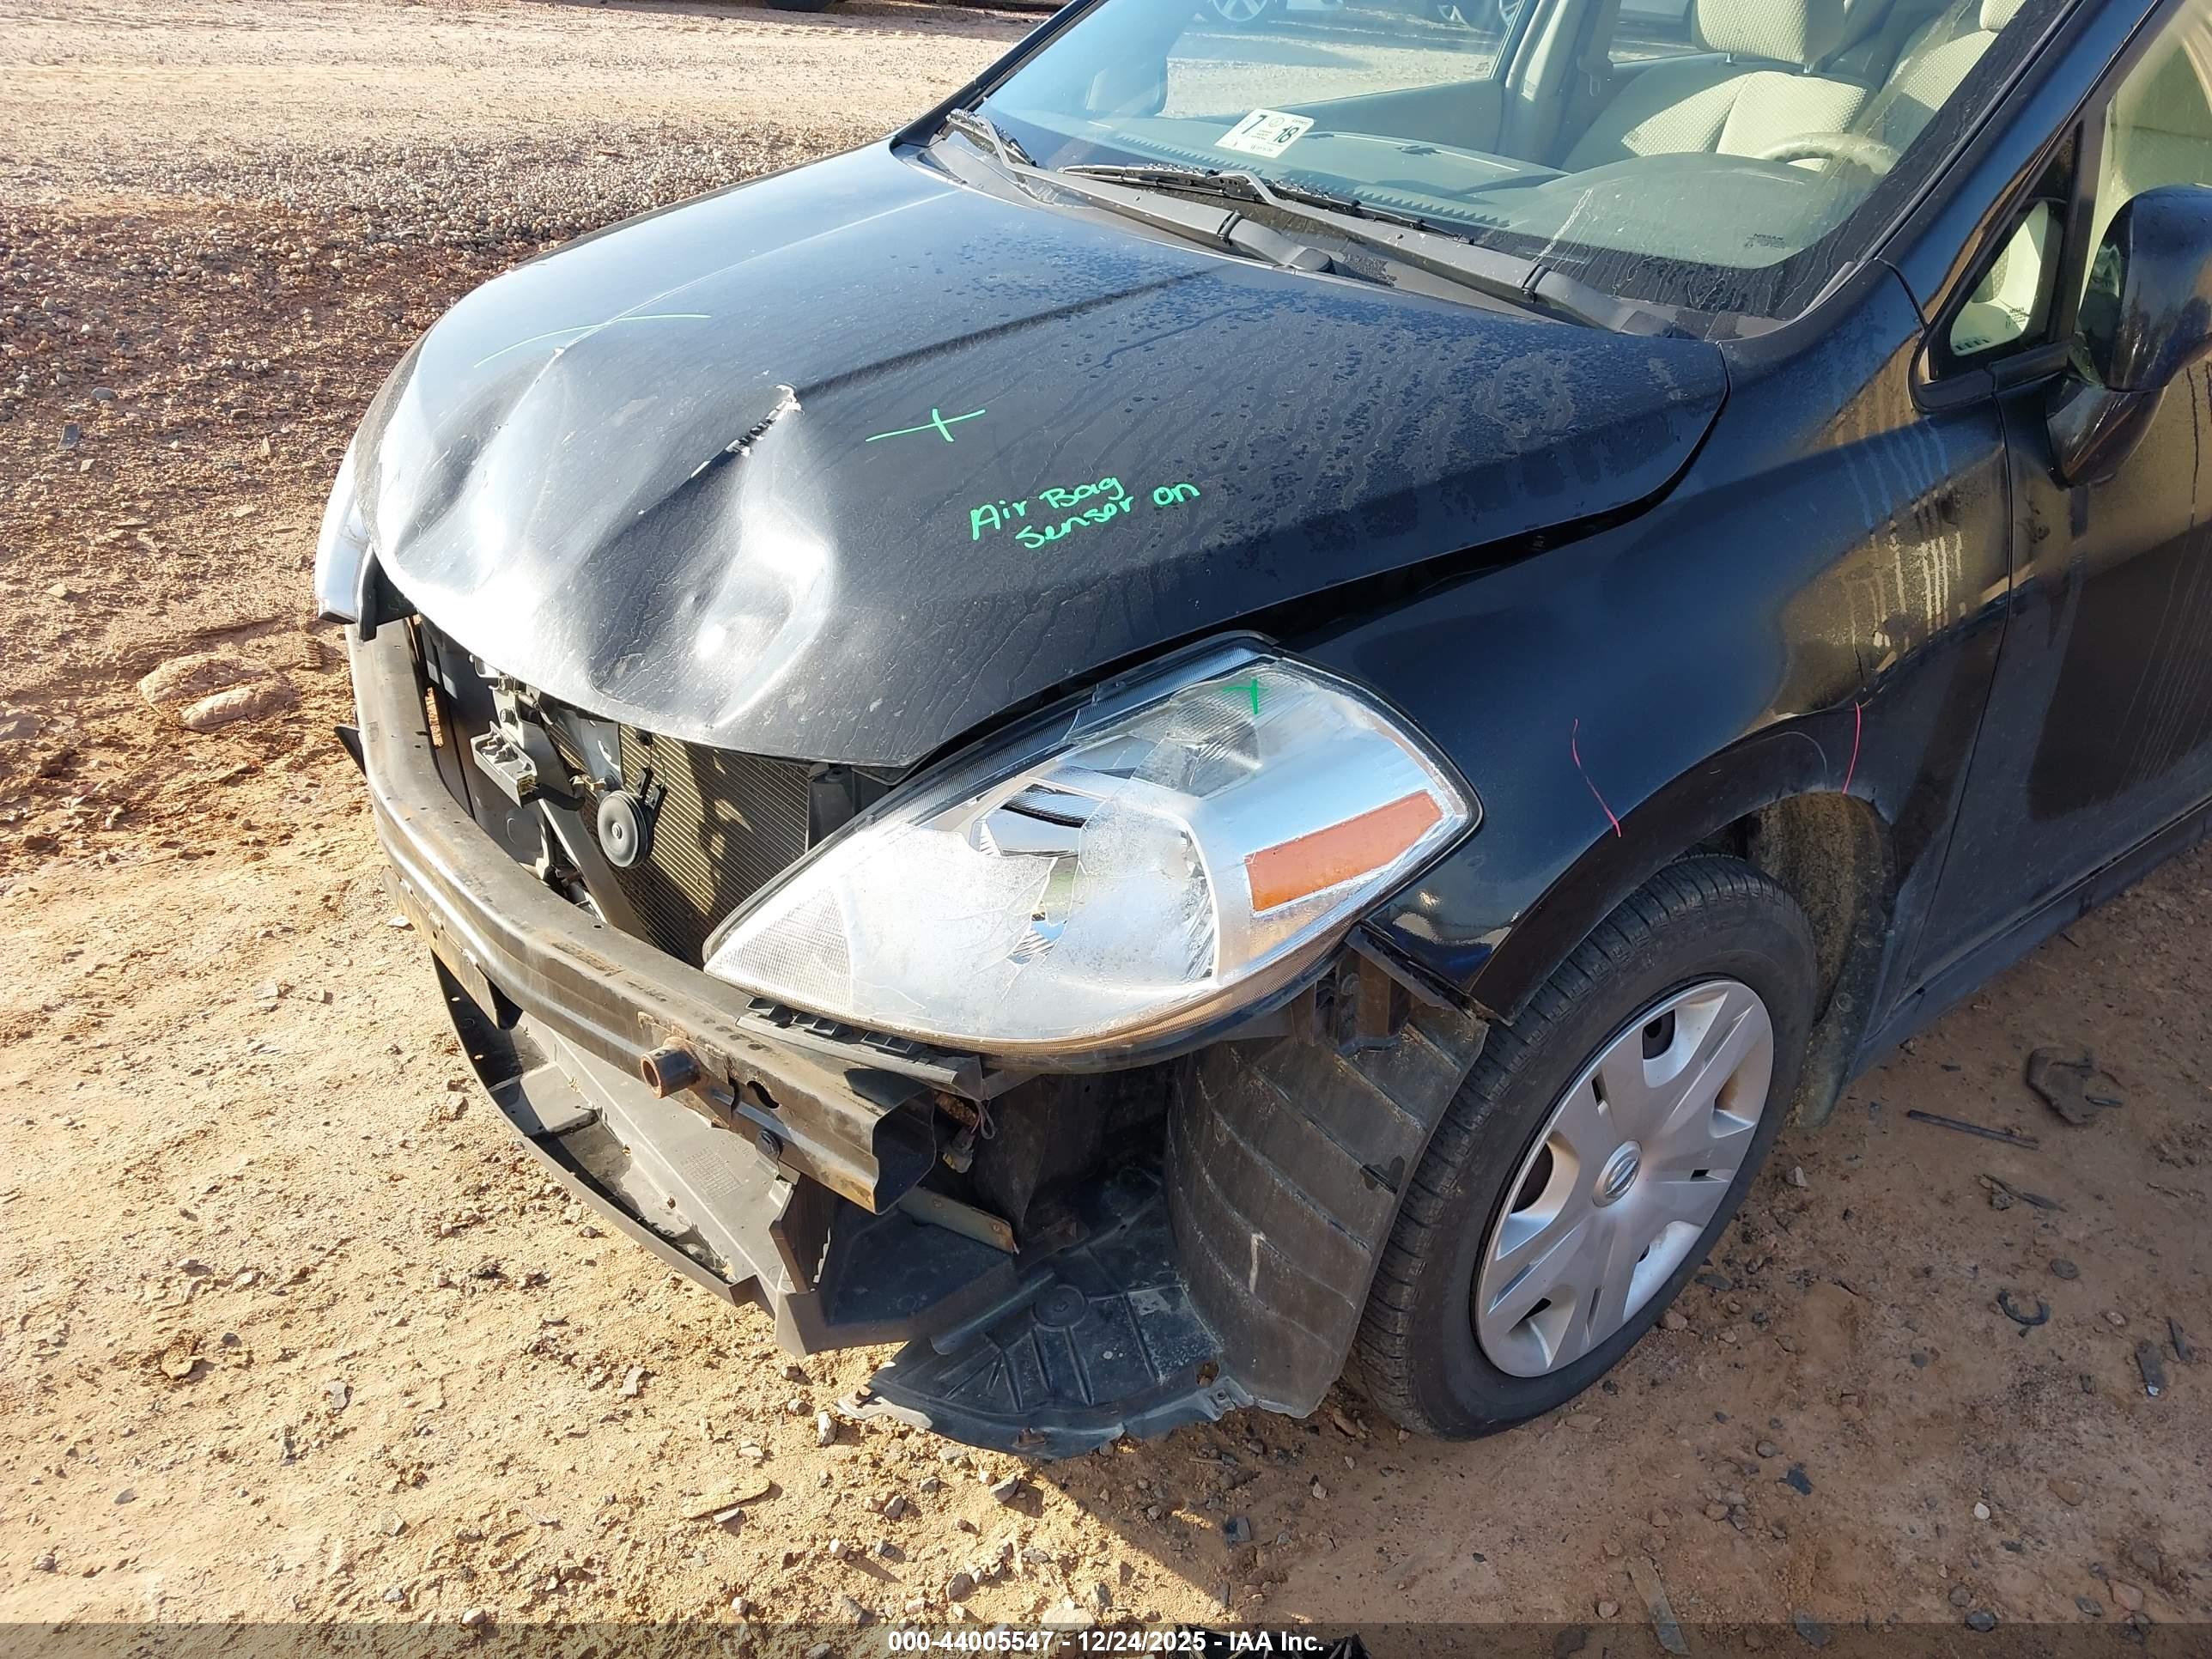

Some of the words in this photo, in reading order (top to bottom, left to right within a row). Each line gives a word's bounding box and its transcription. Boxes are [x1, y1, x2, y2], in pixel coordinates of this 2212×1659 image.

[1241, 114, 1267, 135] 7
[968, 499, 1029, 542] Air
[1038, 476, 1126, 509] Bag
[1152, 482, 1200, 509] on
